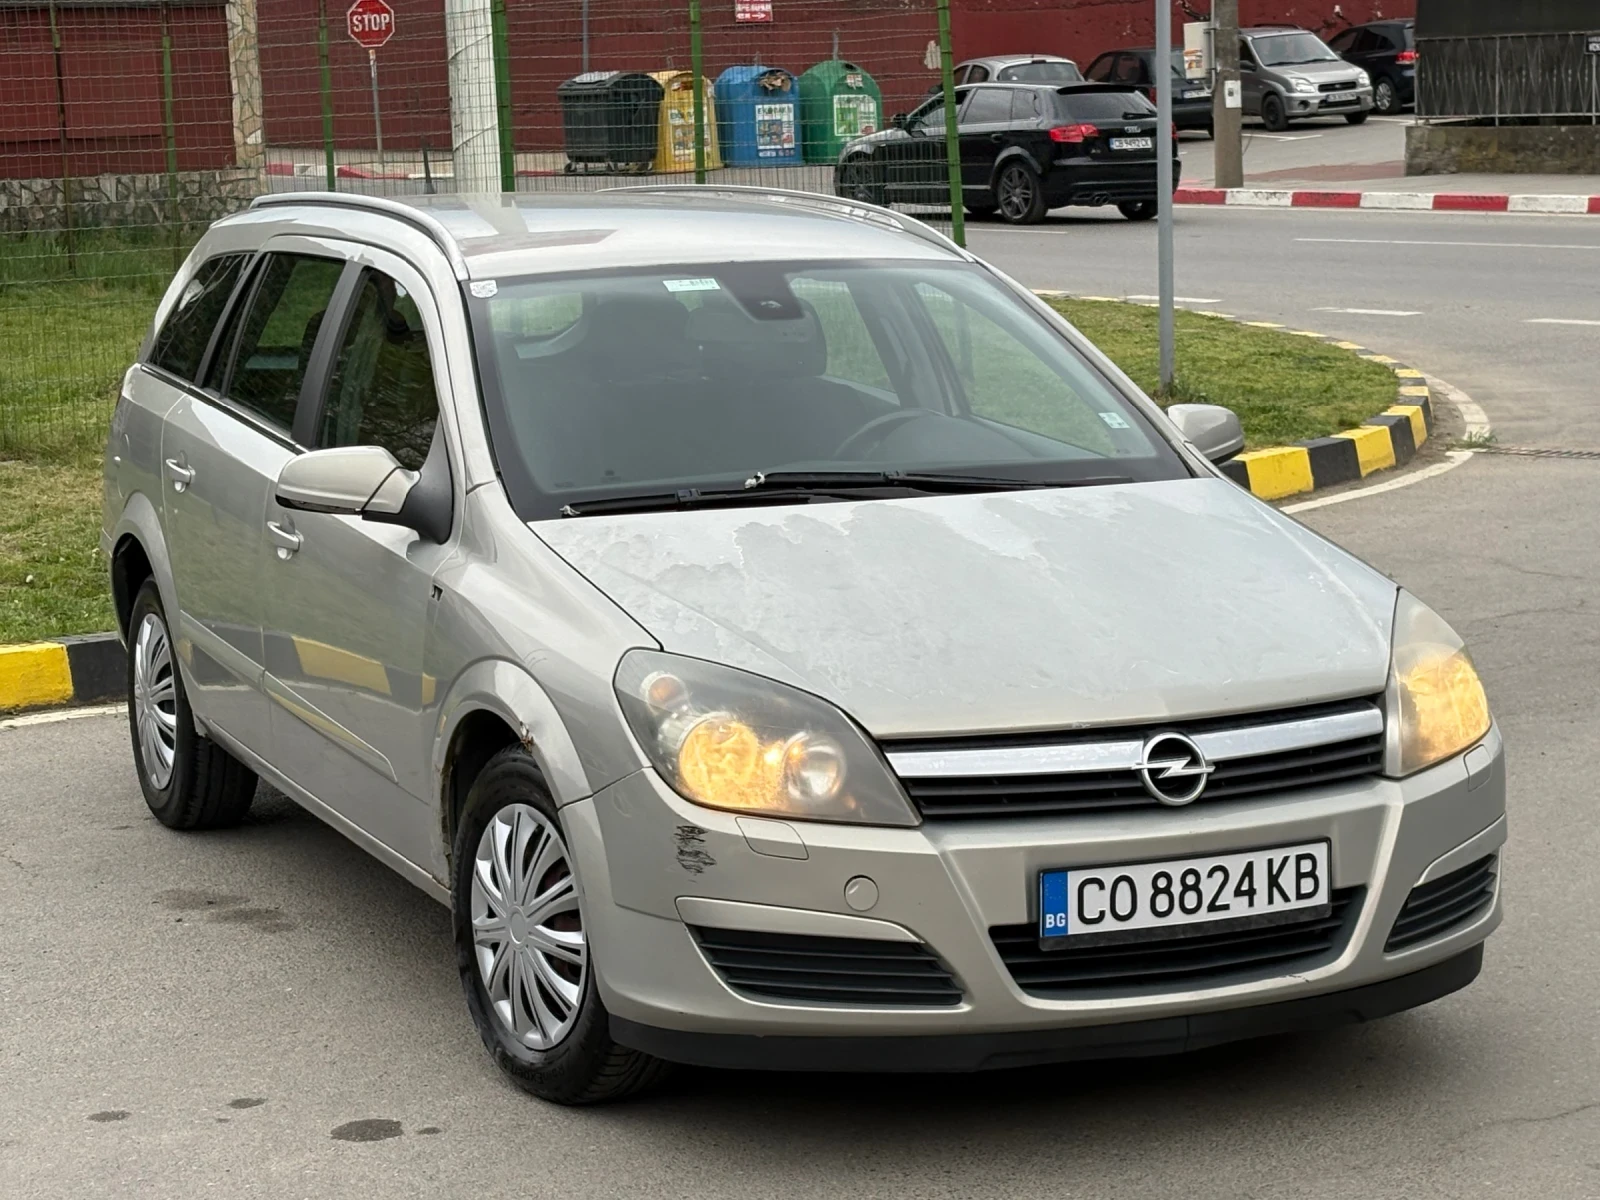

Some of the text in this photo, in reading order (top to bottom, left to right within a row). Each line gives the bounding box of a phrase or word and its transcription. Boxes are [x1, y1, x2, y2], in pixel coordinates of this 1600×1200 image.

[352, 13, 390, 32] STOP
[1077, 852, 1320, 925] CO 8824 KB
[1045, 913, 1066, 929] BG
